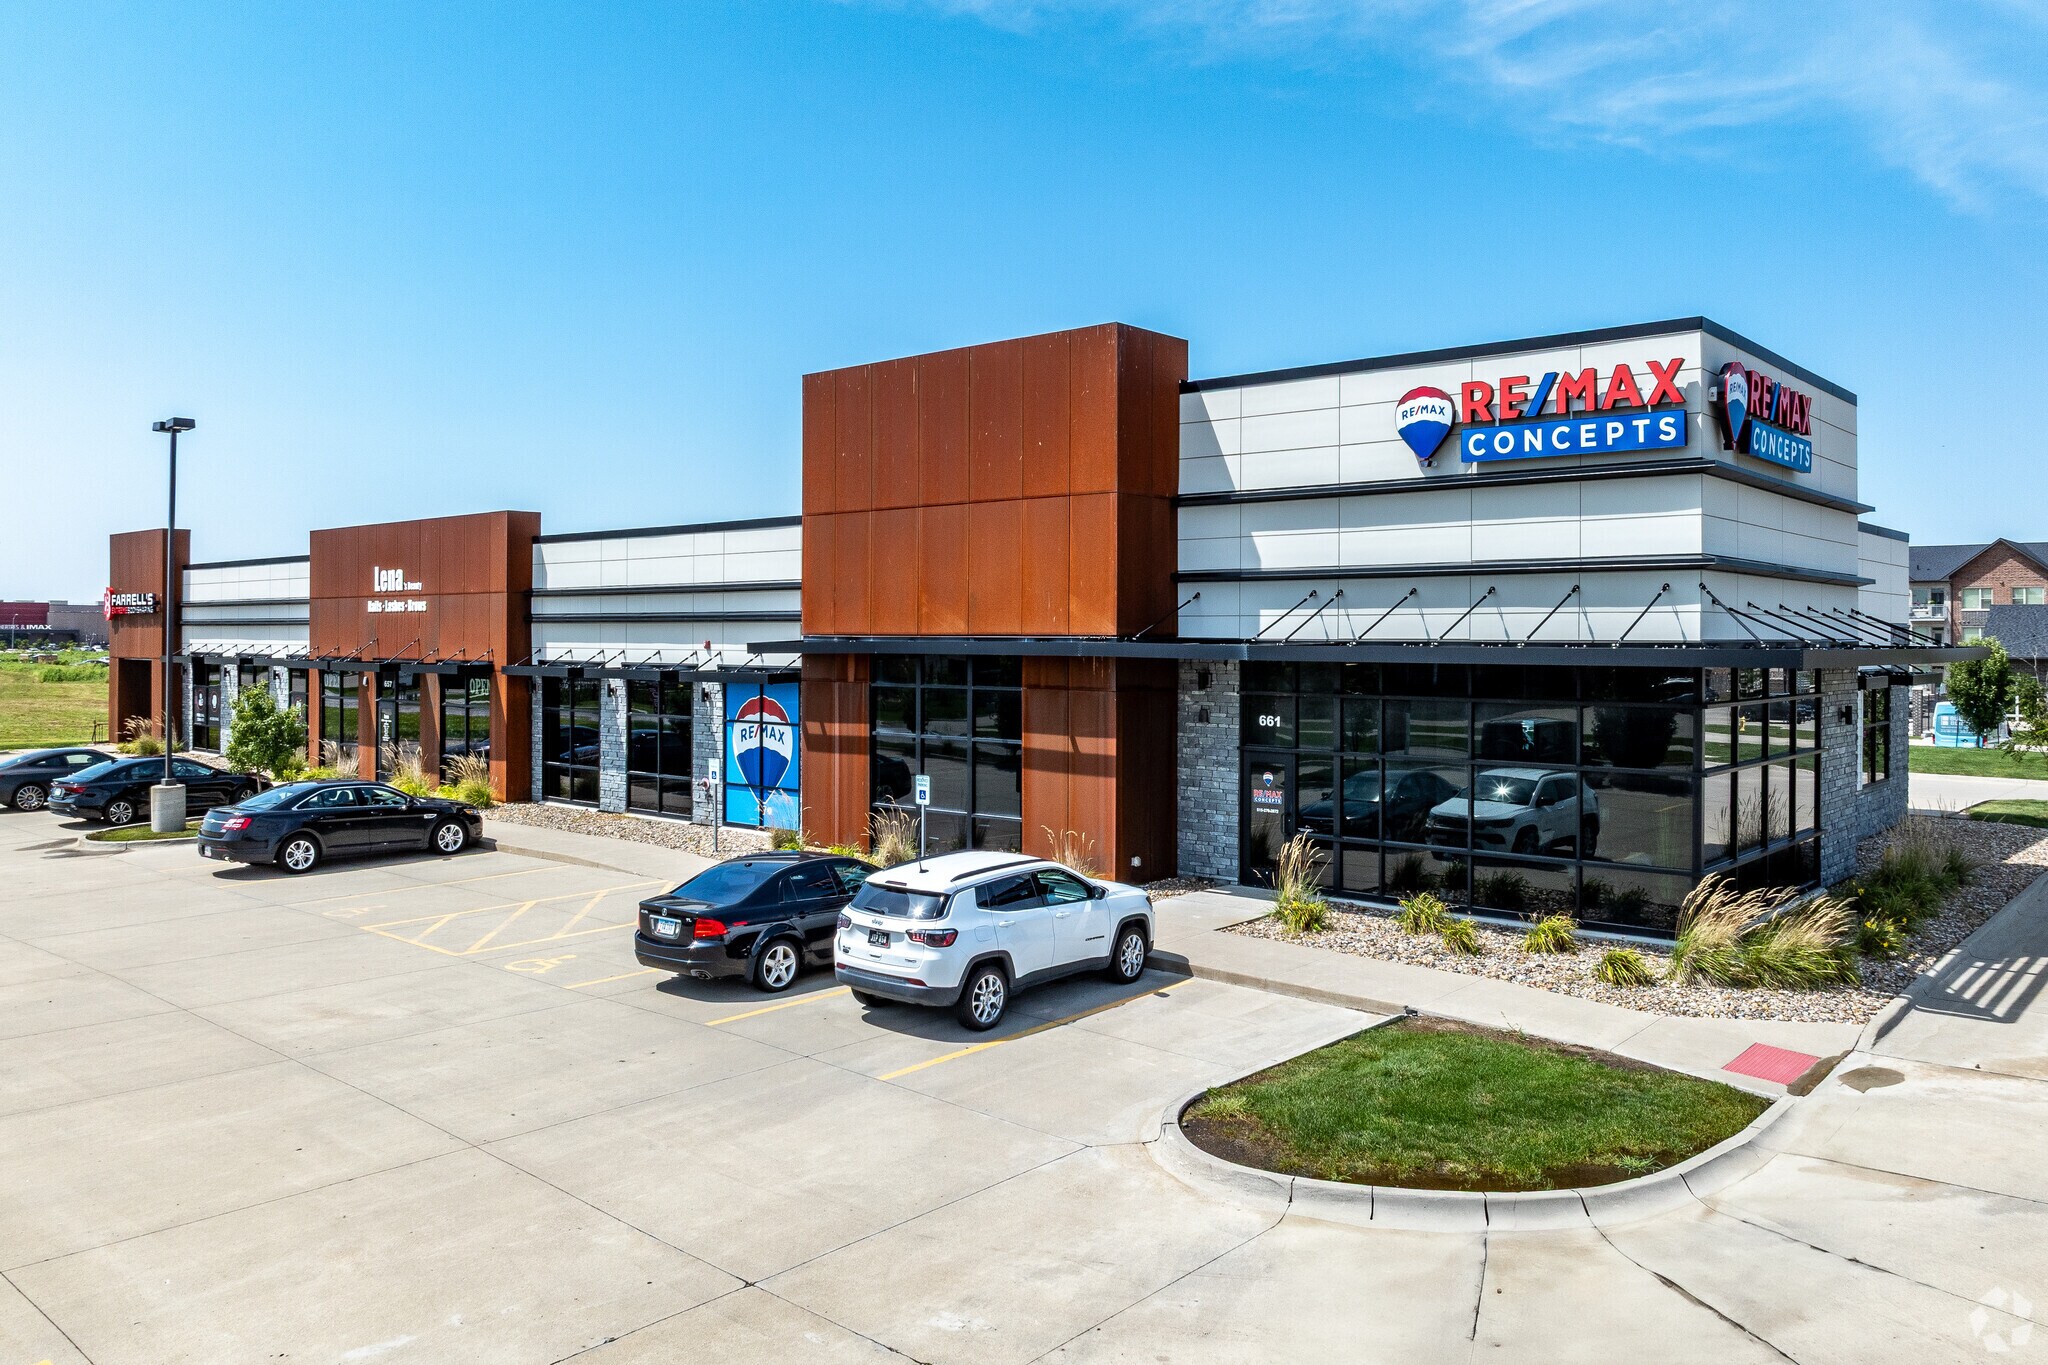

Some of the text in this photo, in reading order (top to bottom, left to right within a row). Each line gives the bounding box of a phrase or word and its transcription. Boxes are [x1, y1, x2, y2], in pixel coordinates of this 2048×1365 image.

[1461, 357, 1686, 424] RE/MAX
[1402, 404, 1446, 421] RE/MAX
[1747, 369, 1813, 436] RE/MAX
[1468, 416, 1678, 456] CONCEPTS
[1753, 427, 1810, 467] CONCEPTS
[111, 593, 153, 606] FARRELL'S
[1258, 715, 1281, 727] 661
[740, 724, 785, 745] RE/MAX
[1253, 789, 1282, 798] RE/MAX
